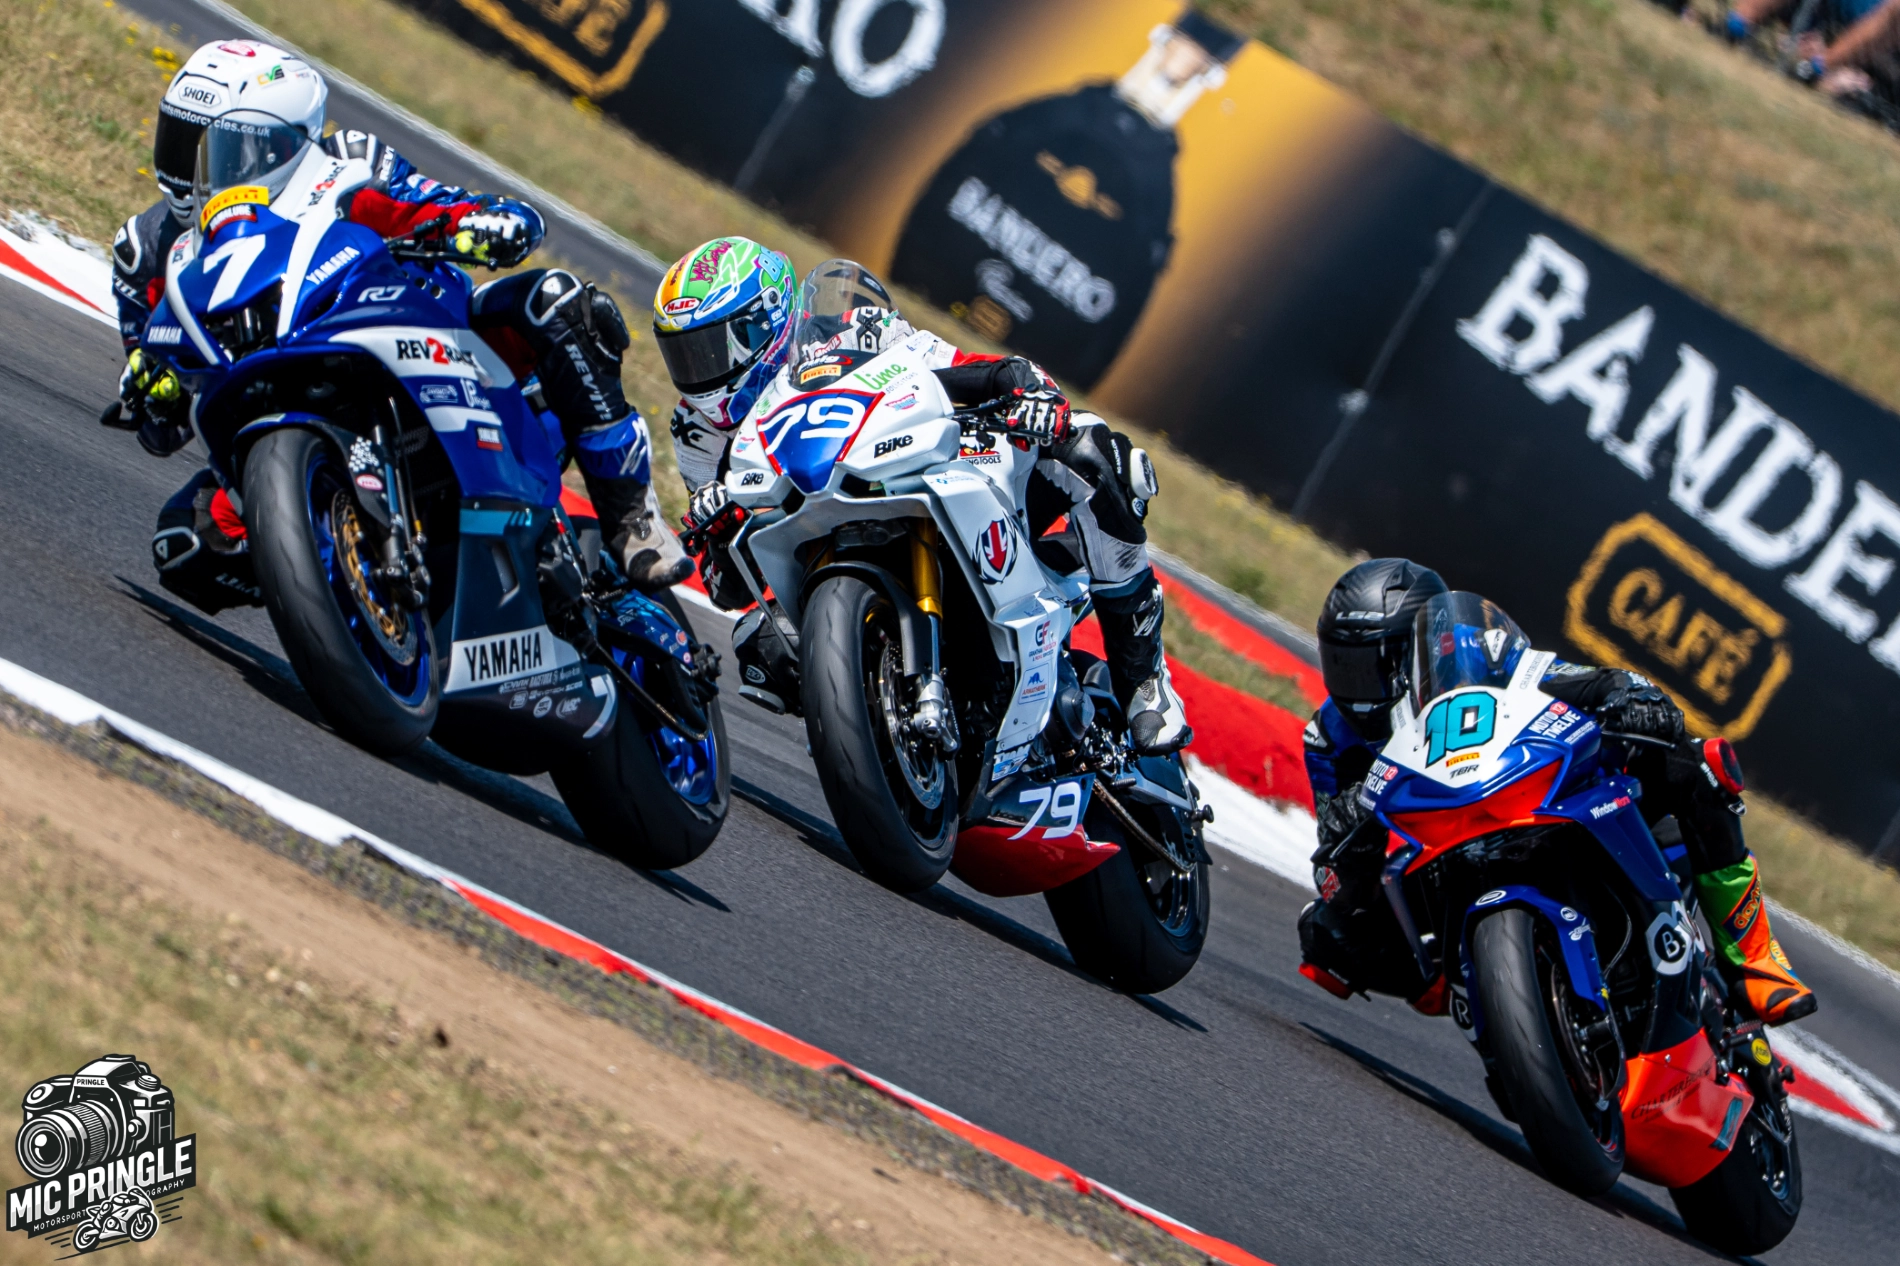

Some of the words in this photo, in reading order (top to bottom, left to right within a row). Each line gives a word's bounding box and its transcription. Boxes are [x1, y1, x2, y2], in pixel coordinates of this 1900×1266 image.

[183, 86, 216, 105] SHOEI
[949, 176, 1115, 323] BANDERO
[203, 233, 266, 313] 7
[305, 245, 360, 285] YAMAHA
[357, 286, 406, 302] R7
[667, 299, 696, 312] HJC
[147, 326, 183, 344] YAMAHA
[803, 366, 838, 381] PIRELLI
[853, 363, 908, 391] lime
[758, 397, 866, 455] 79
[873, 434, 914, 459] Bike
[1455, 232, 1900, 678] BANDE
[741, 472, 764, 487] Bike
[1335, 610, 1385, 621] LS2
[1035, 620, 1051, 646] GF
[1608, 567, 1761, 703] CAFÉ
[464, 632, 543, 682] YAMAHA
[1424, 691, 1498, 769] 10
[1528, 711, 1559, 735] MOTO
[1541, 710, 1581, 739] TWELVE
[1446, 751, 1480, 768] PIRELLI
[1450, 764, 1480, 779] TBR
[1363, 772, 1388, 795] TWELVE
[1006, 781, 1081, 840] 79
[1662, 931, 1680, 958] B
